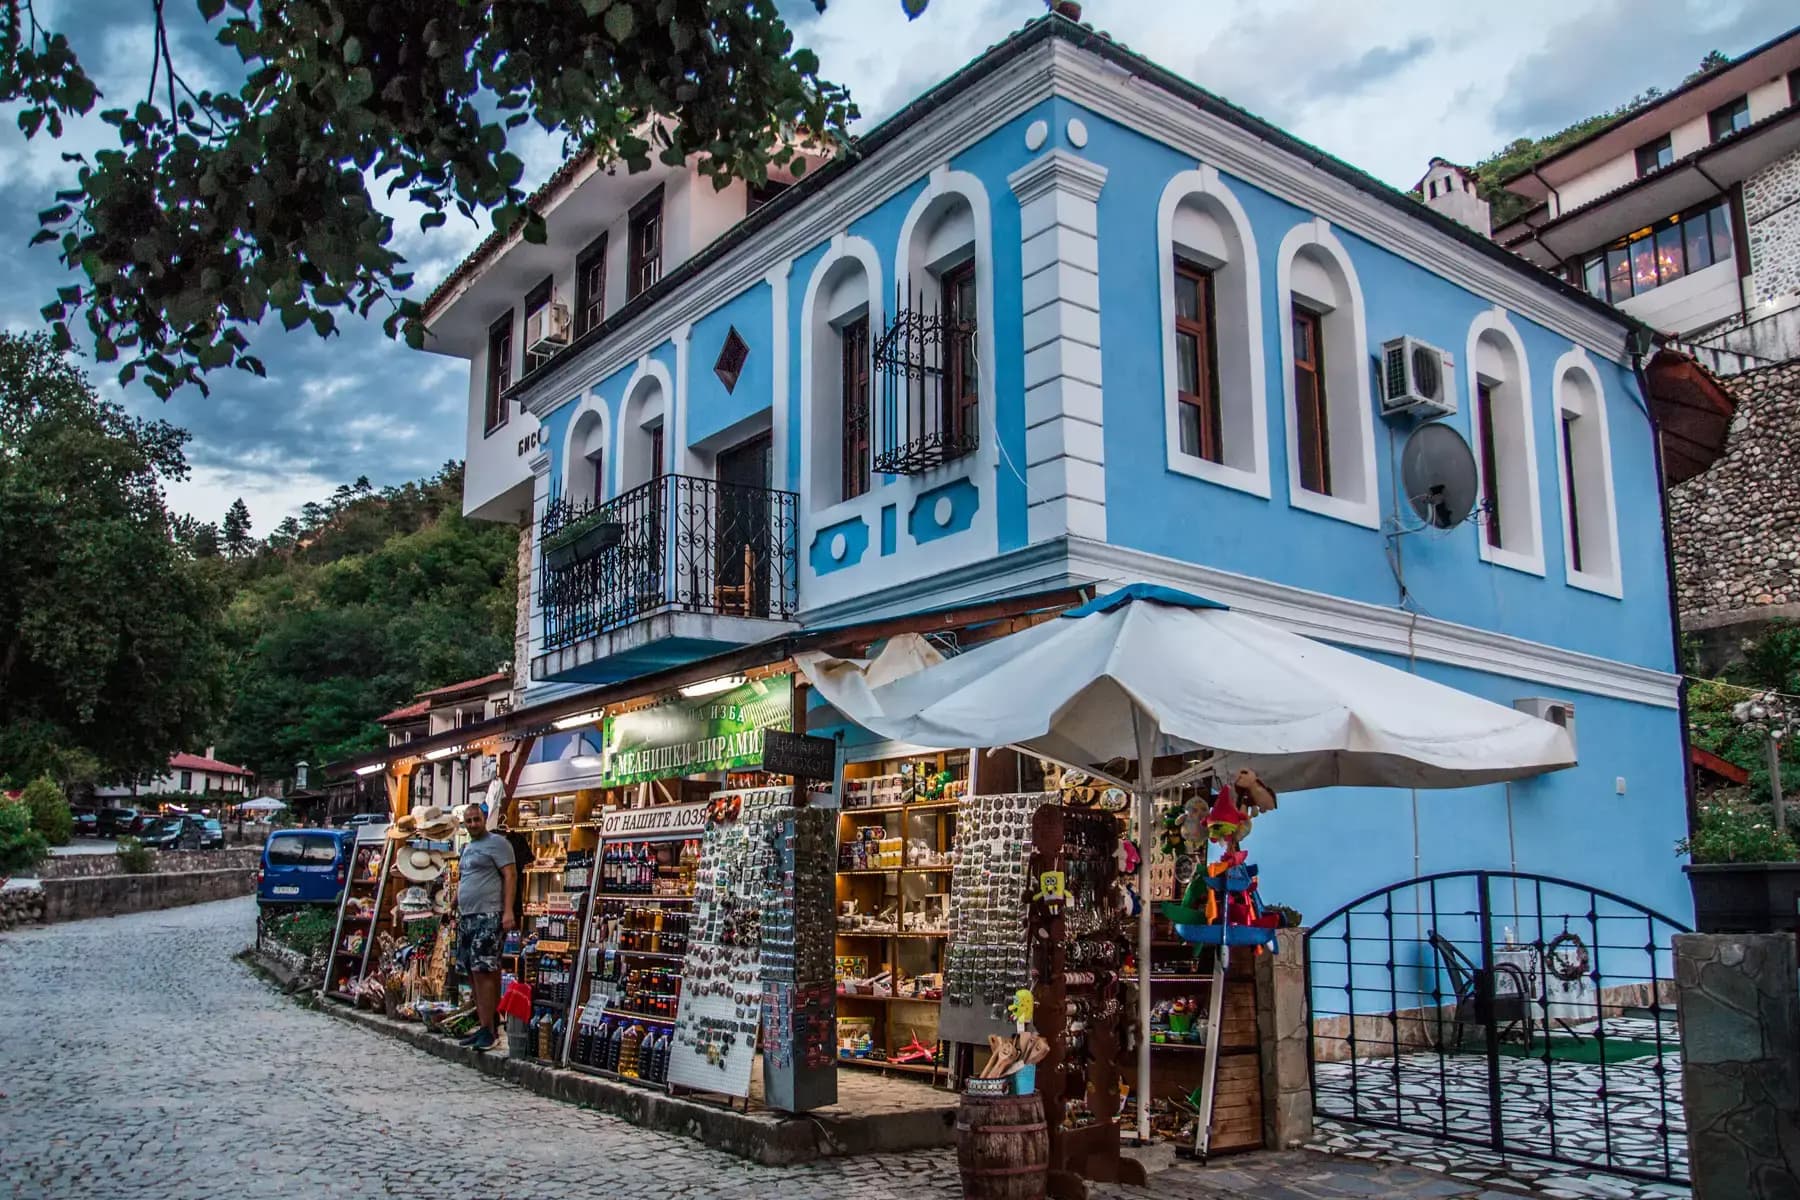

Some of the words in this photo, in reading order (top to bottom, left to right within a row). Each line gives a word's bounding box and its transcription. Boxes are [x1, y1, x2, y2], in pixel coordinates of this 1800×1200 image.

[711, 705, 744, 722] ИЗБА
[605, 816, 621, 832] ОТ
[621, 811, 672, 831] НАШИТЕ
